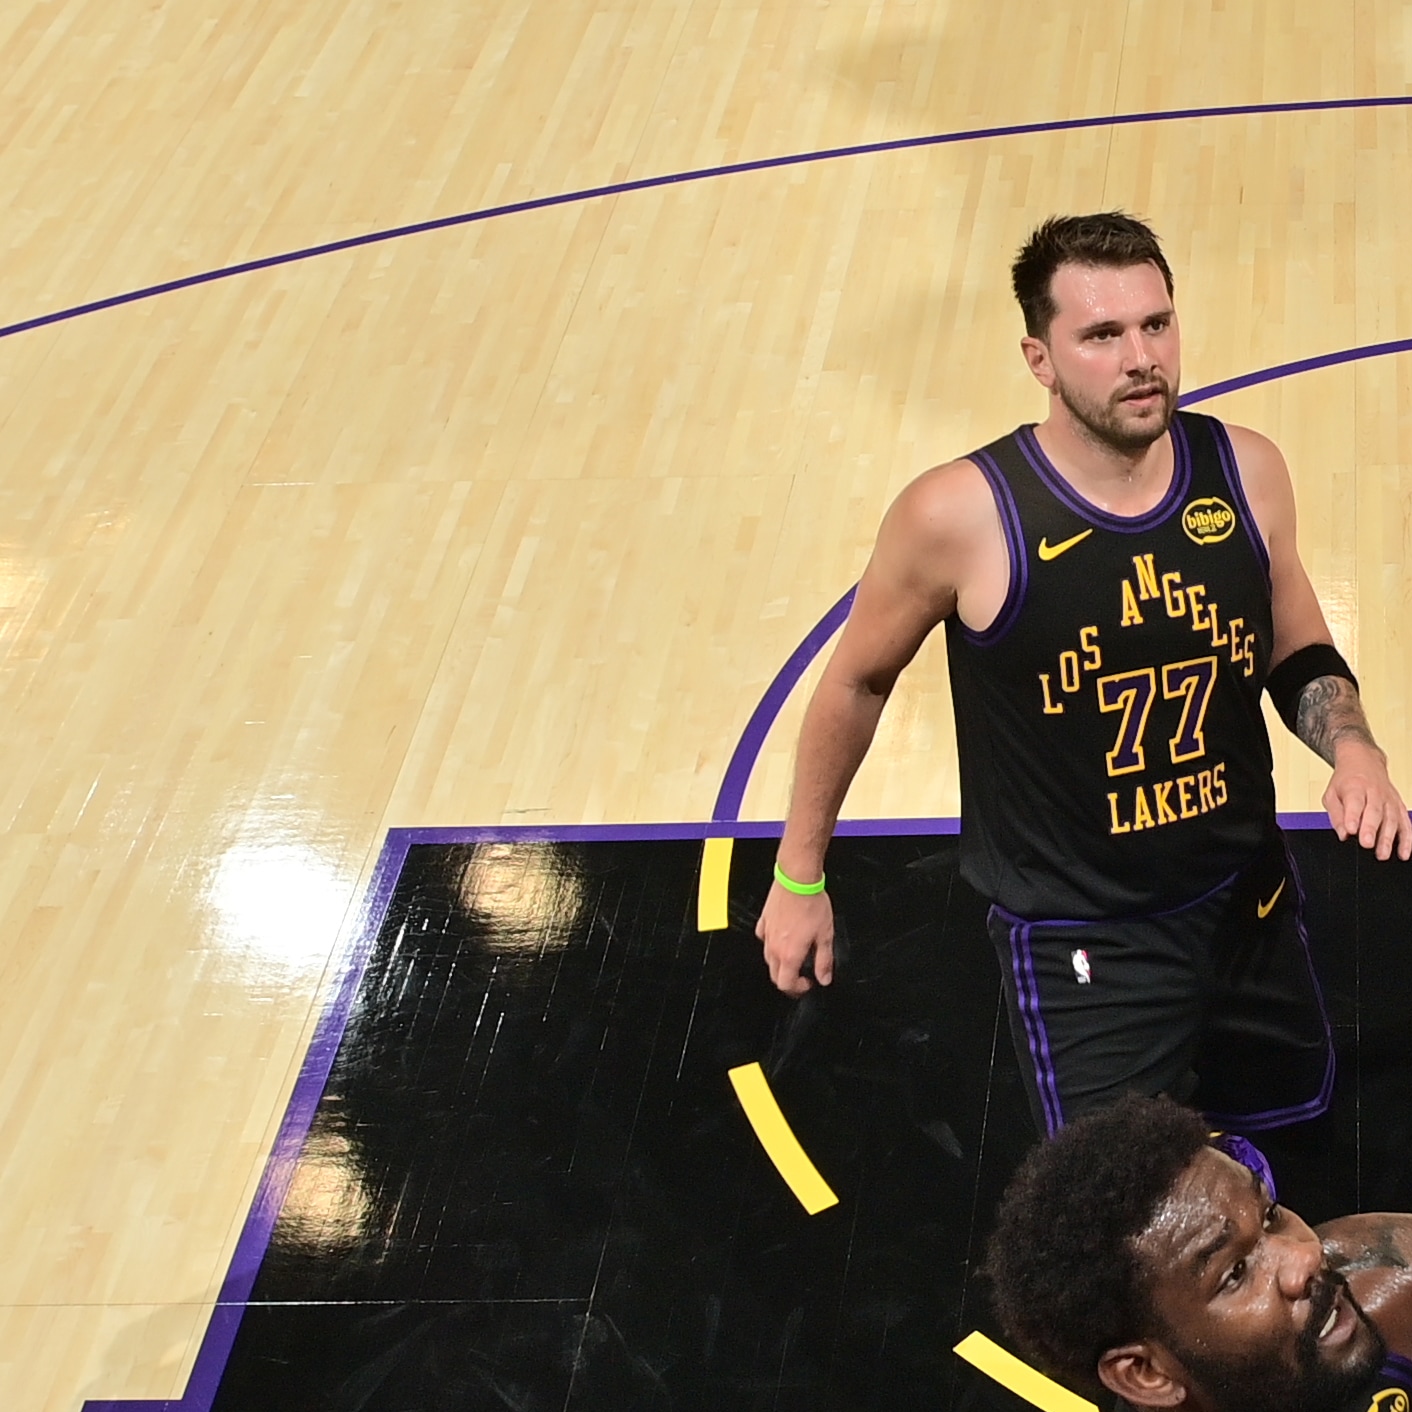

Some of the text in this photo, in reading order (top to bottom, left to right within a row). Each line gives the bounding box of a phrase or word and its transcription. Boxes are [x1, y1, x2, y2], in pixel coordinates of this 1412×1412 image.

[1186, 508, 1231, 529] bibigo
[1039, 553, 1255, 714] LOS ANGELES
[1097, 655, 1218, 777] 77
[1107, 762, 1228, 835] LAKERS
